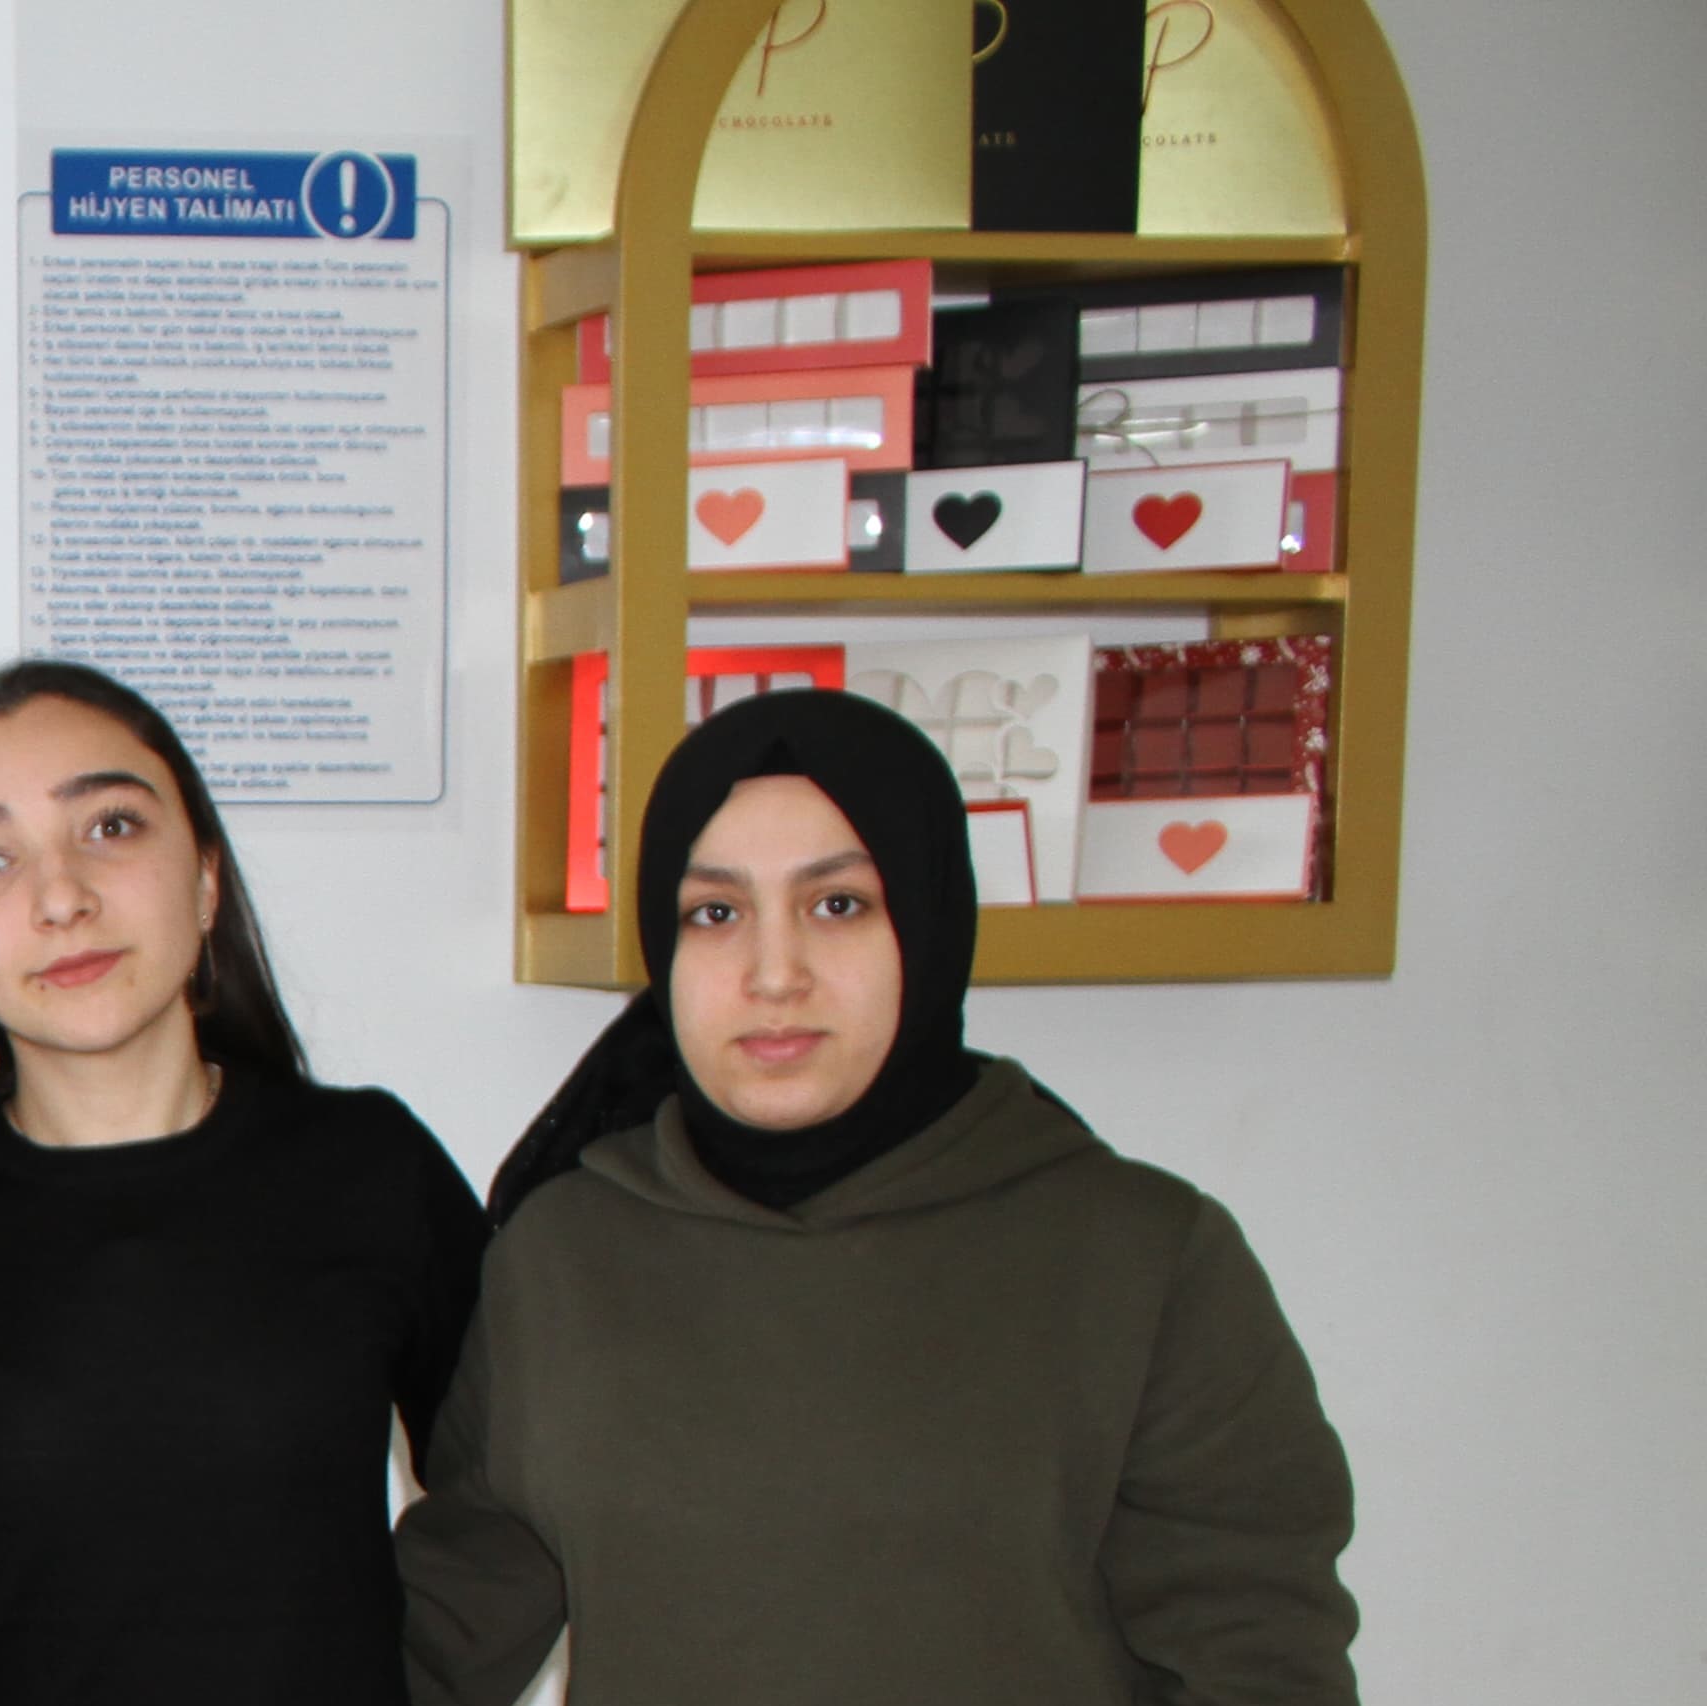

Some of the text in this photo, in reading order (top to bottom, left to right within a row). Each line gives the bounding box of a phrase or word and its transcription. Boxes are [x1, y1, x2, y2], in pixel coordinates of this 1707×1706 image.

[718, 113, 833, 129] CHOCOLATE
[1142, 132, 1217, 147] COLATE
[109, 165, 254, 191] PERSONEL
[69, 190, 296, 221] HİJYEN TALİMATI
